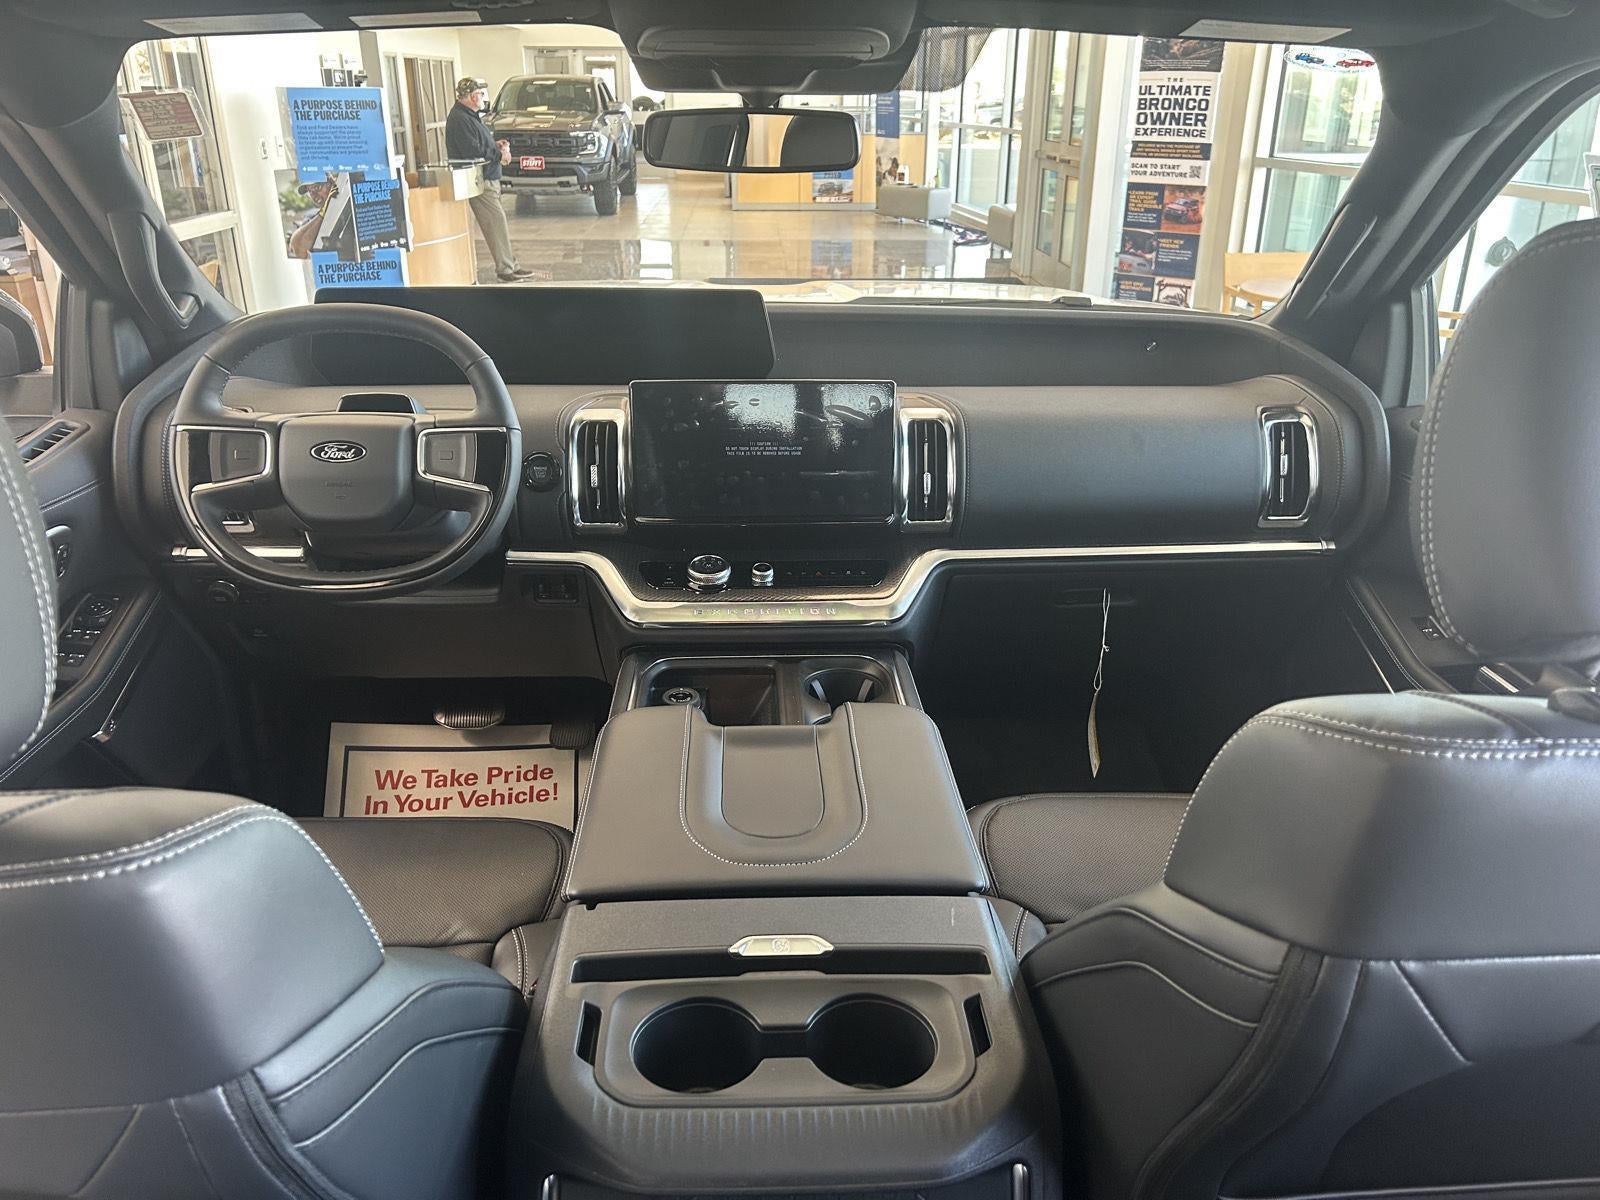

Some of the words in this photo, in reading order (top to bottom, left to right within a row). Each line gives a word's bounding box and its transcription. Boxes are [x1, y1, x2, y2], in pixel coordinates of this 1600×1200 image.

[1138, 85, 1211, 96] ULTIMATE
[293, 100, 299, 110] A
[301, 100, 343, 110] PURPOSE
[345, 100, 377, 110] BEHIND
[1136, 98, 1210, 112] BRONCO
[294, 110, 312, 120] THE
[314, 110, 361, 120] PURCHASE
[1136, 112, 1207, 127] OWNER
[1134, 128, 1206, 138] EXPERIENCE
[318, 265, 324, 273] A
[326, 262, 365, 273] PURPOSE
[366, 260, 397, 270] BEHIND
[319, 274, 336, 284] THE
[337, 271, 382, 283] PURCHASE
[320, 444, 355, 458] Ford
[374, 769, 417, 790] We
[421, 768, 478, 789] Take
[487, 764, 554, 785] Pride
[364, 795, 389, 815] In
[394, 793, 453, 813] Your
[458, 782, 559, 809] Vehicle!
